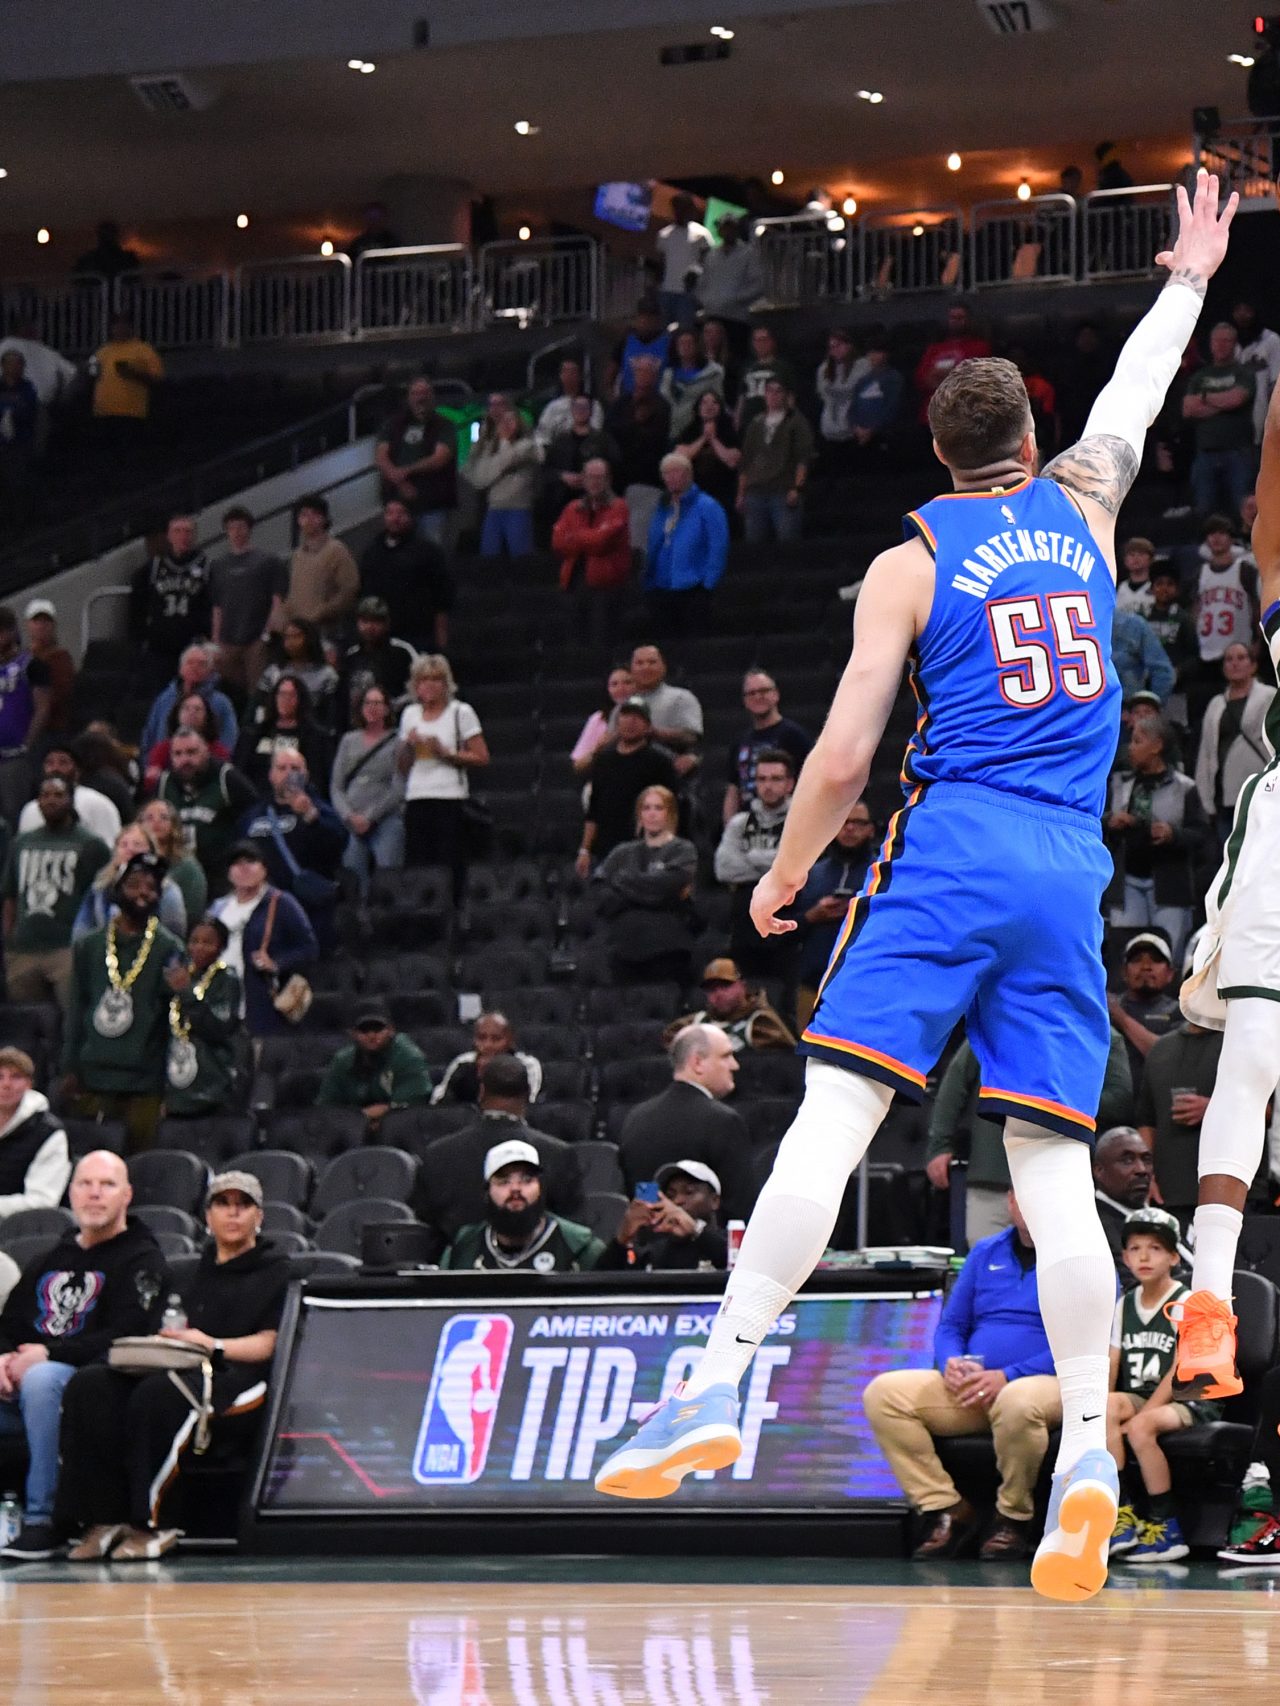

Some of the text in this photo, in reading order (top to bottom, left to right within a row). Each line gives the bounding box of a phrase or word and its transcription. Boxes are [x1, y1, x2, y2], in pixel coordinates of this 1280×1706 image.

[987, 1, 1031, 32] 117
[951, 529, 1096, 599] HARTENSTEIN
[163, 594, 189, 616] 34
[1201, 611, 1234, 637] 33
[985, 591, 1107, 709] 55
[528, 1313, 798, 1338] AMERICAN EXSS
[1127, 1353, 1161, 1389] 34
[510, 1345, 791, 1481] TIP-OF
[424, 1443, 461, 1473] NBA
